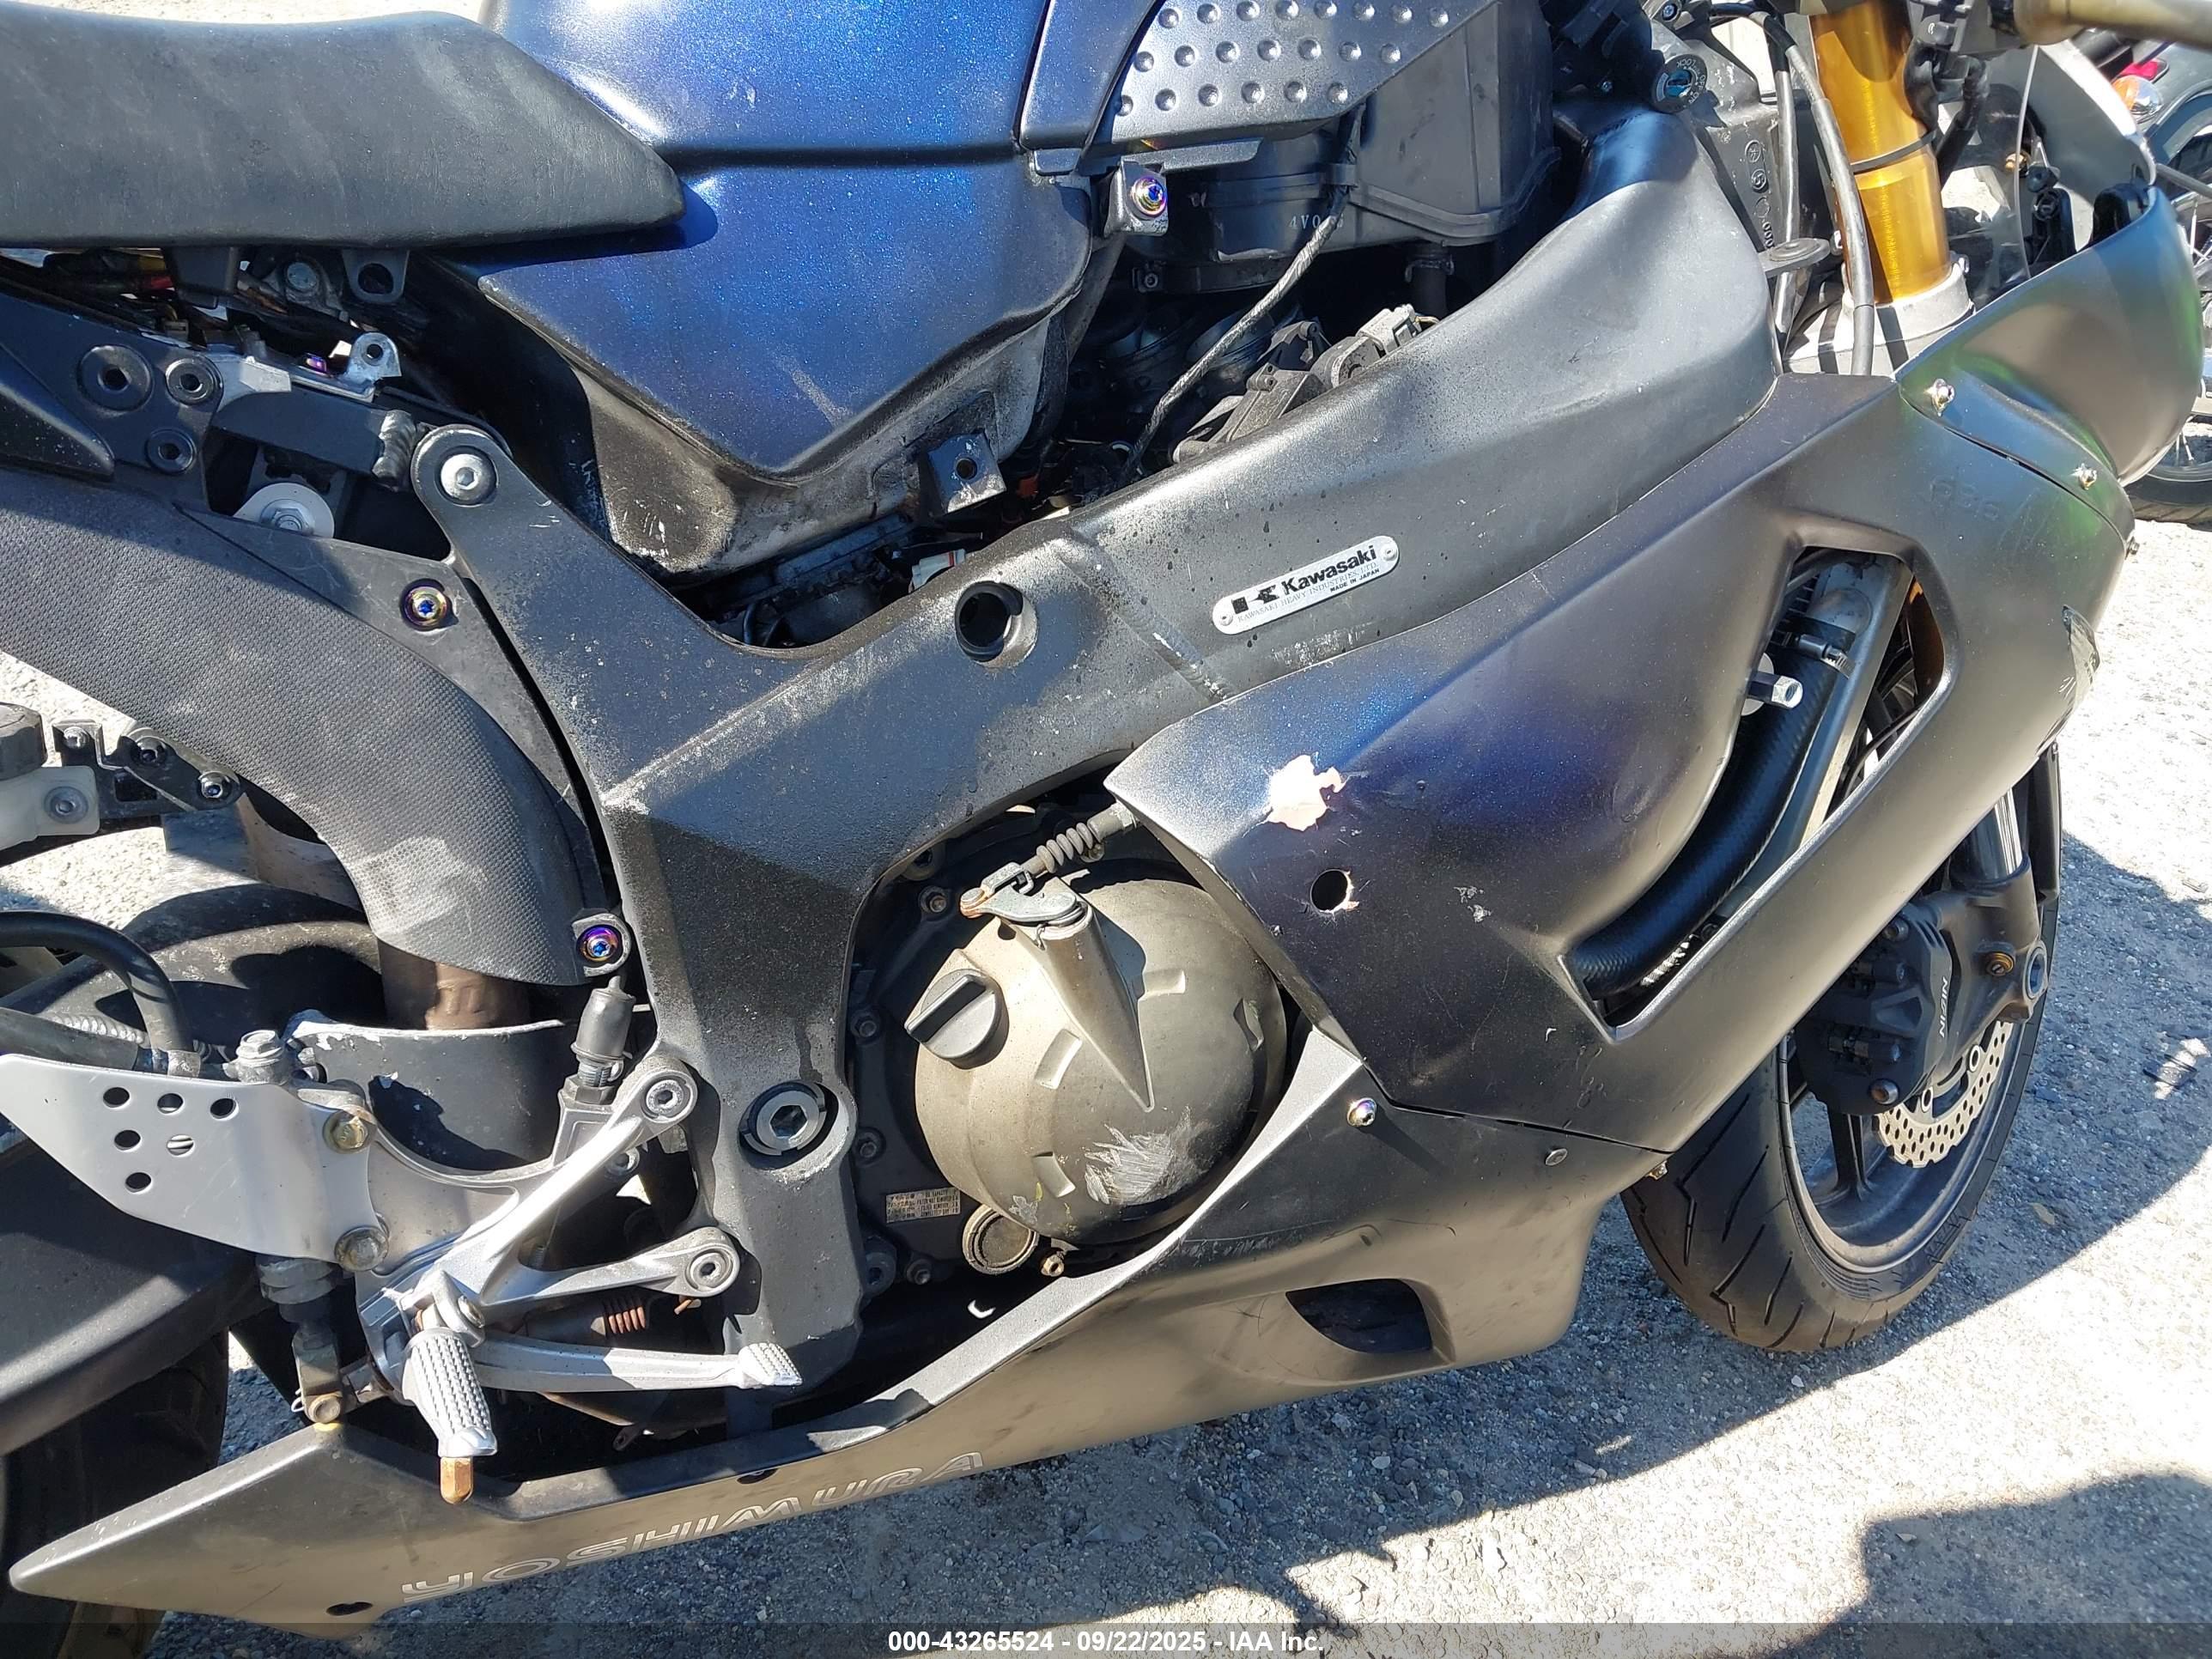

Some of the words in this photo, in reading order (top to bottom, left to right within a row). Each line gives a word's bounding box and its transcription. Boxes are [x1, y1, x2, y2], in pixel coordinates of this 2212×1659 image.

[1281, 544, 1377, 596] Kawasaki
[1329, 580, 1348, 593] MADE
[1359, 568, 1380, 581] JAPAN
[402, 1452, 983, 1604] YOSHIMURA
